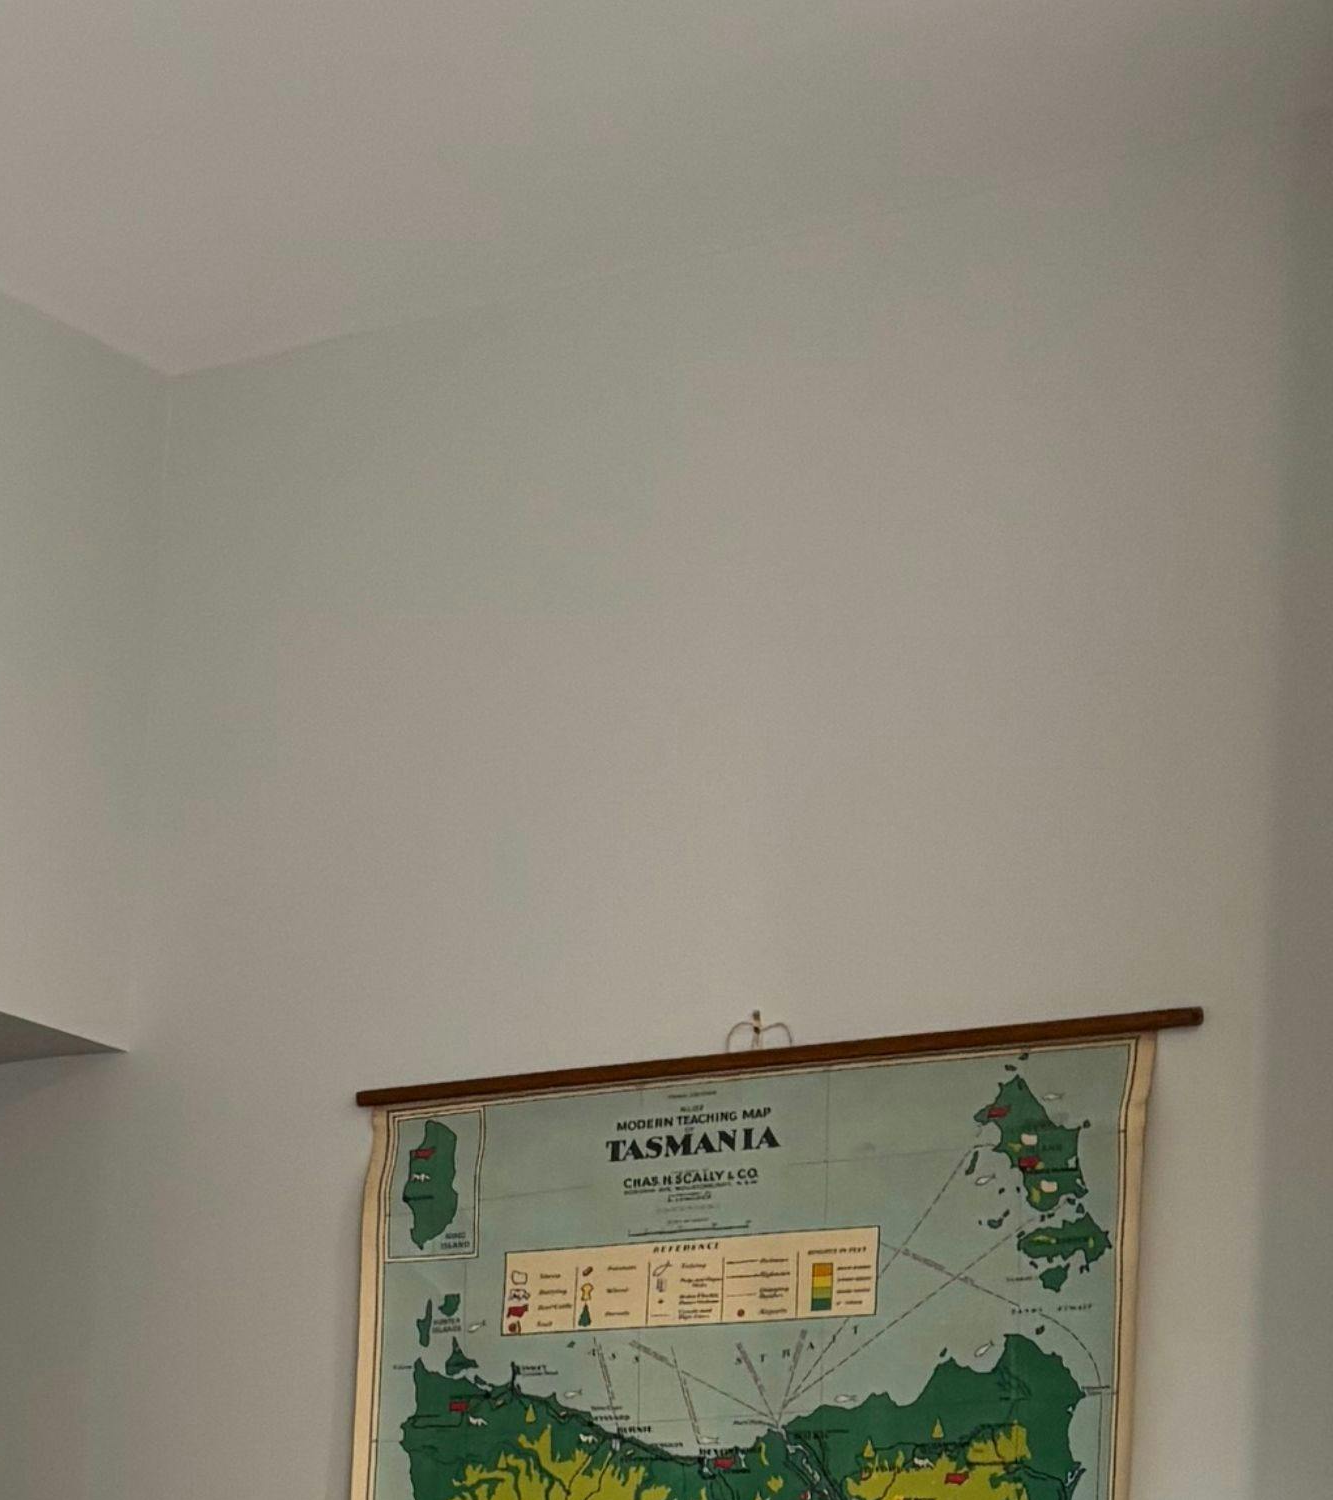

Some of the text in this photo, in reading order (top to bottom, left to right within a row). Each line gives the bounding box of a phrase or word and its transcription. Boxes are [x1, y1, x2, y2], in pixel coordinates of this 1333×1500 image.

[616, 1106, 771, 1132] MODERN TEACHING MAP
[605, 1125, 781, 1163] TASMANIA
[675, 1169, 725, 1185] SCALLY
[441, 1241, 470, 1249] ISLAND
[653, 1242, 720, 1254] REFERENCE
